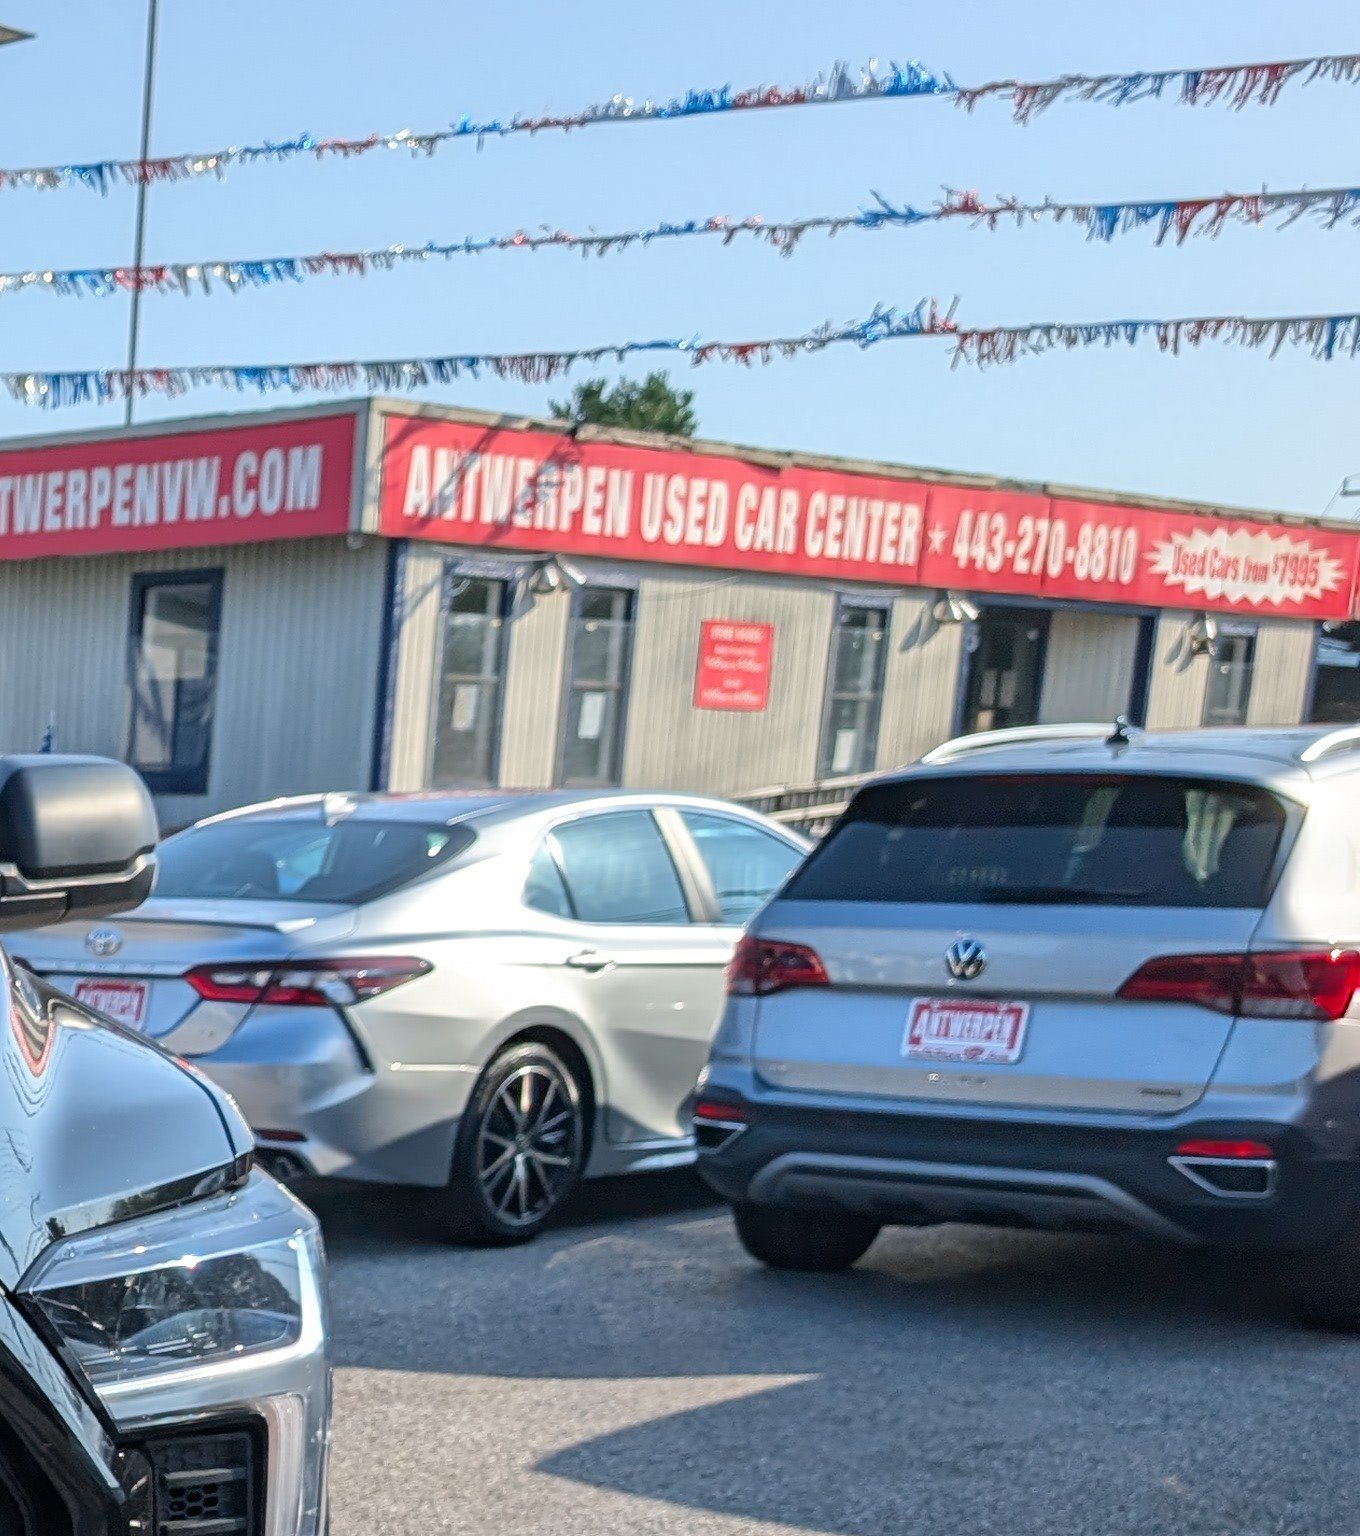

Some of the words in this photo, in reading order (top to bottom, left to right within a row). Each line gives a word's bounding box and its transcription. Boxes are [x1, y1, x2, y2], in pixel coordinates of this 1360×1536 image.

[402, 444, 635, 539] ANTWERPEN
[640, 470, 729, 549] USED
[733, 482, 800, 556] CAR
[804, 490, 921, 567] CENTER
[951, 508, 1140, 585] 443-270-8810
[1172, 545, 1207, 576] Used
[1209, 548, 1239, 582] Cars
